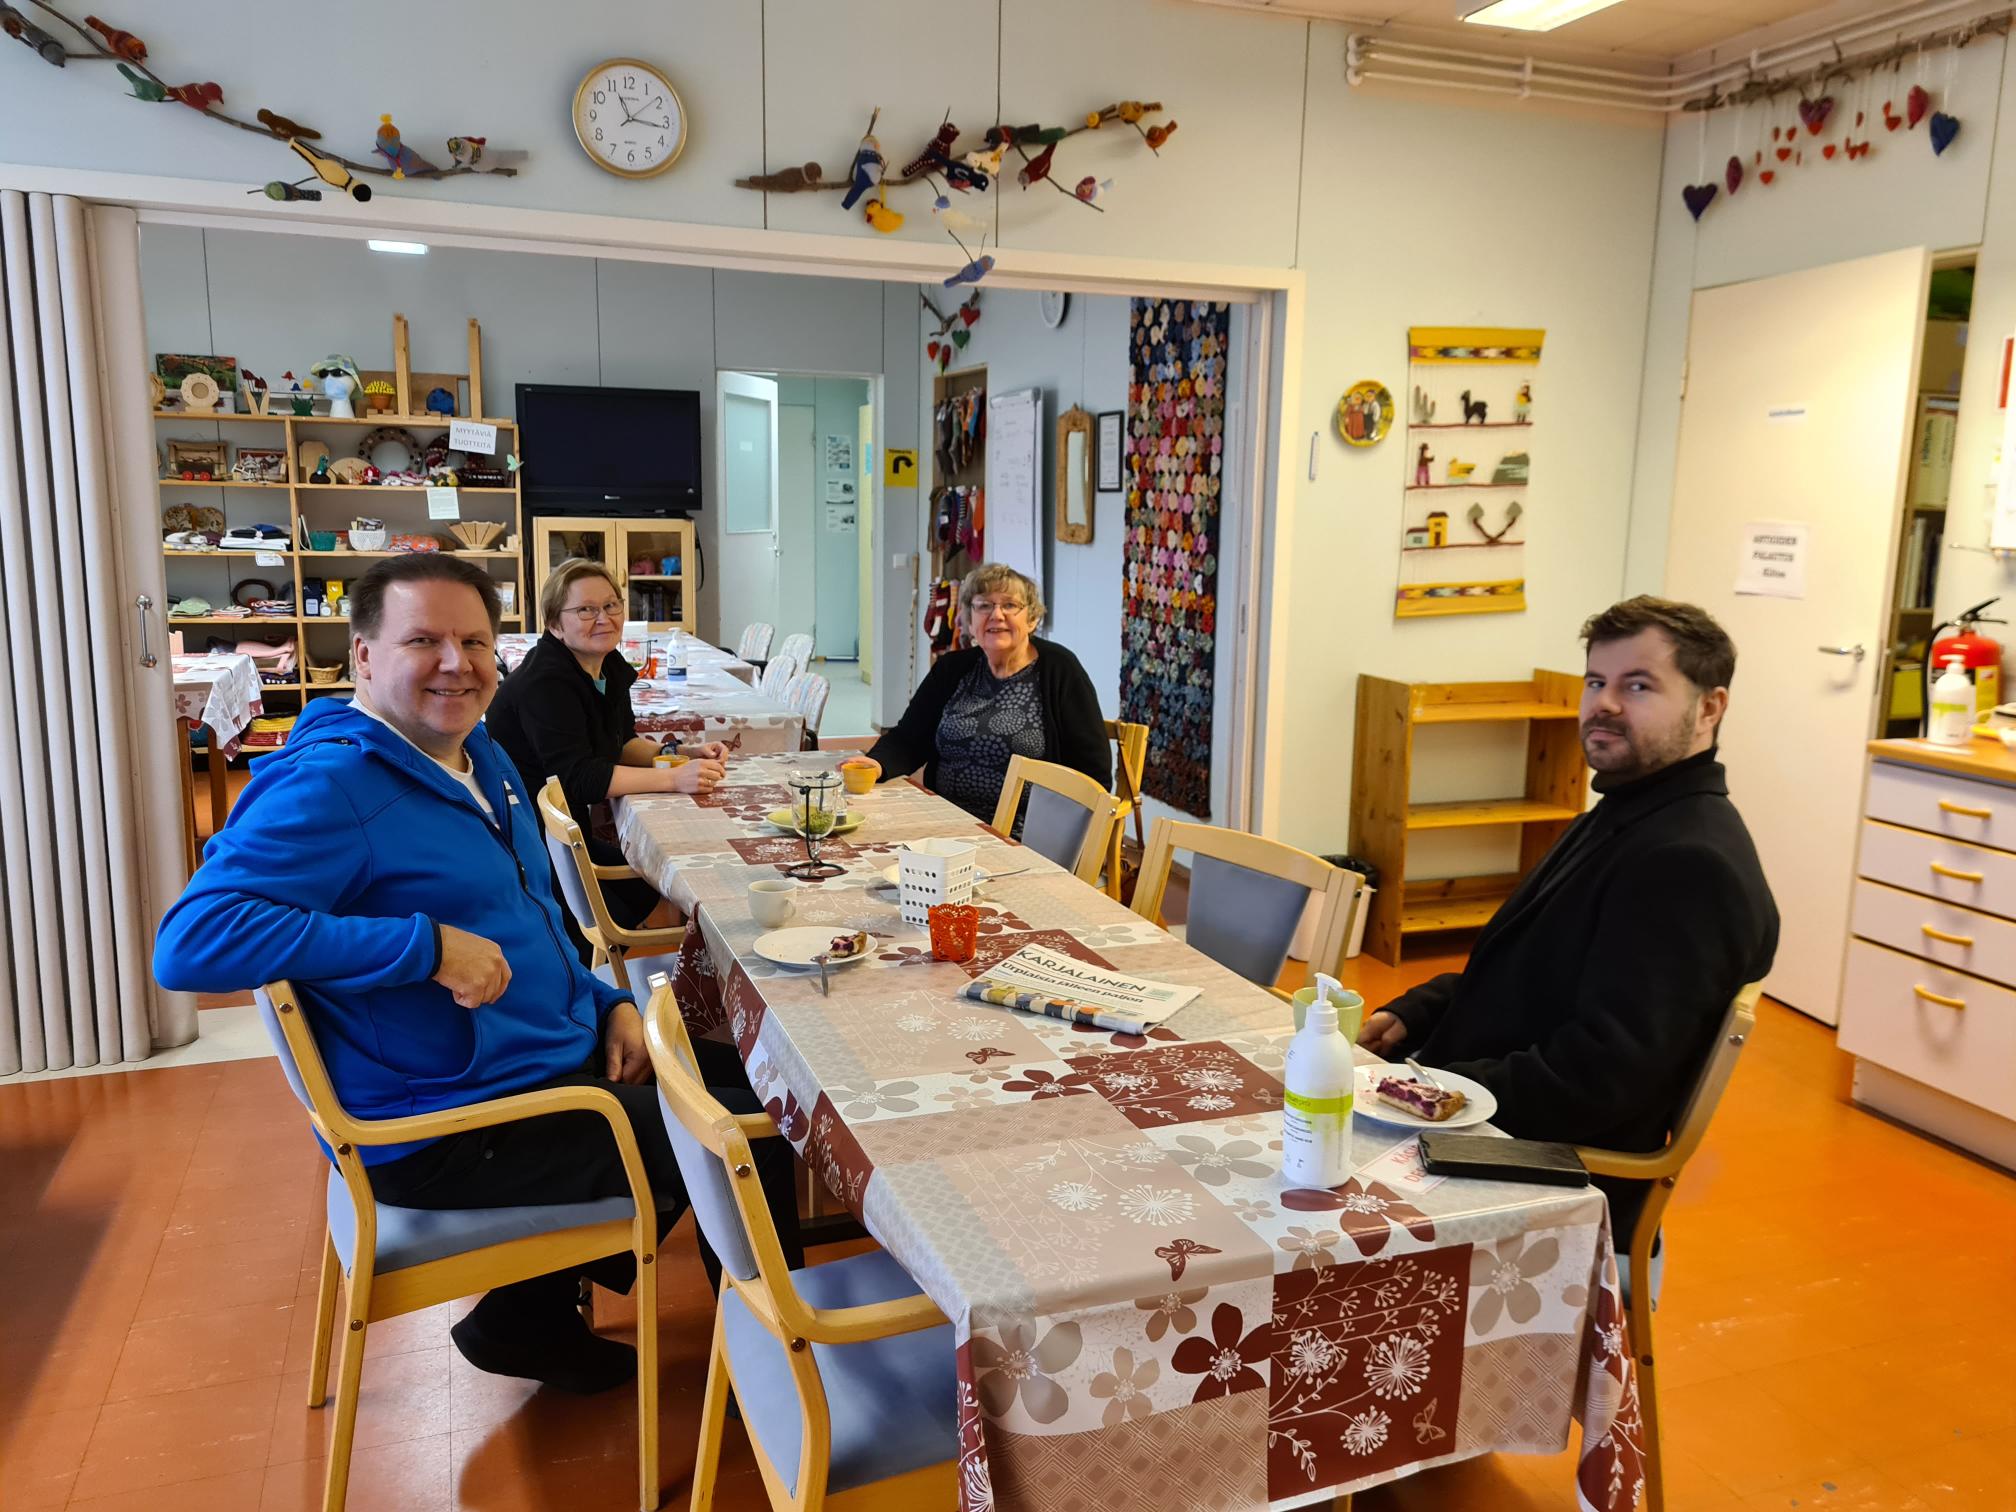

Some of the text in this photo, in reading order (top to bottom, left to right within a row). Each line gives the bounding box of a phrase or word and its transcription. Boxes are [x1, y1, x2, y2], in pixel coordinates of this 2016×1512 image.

[607, 79, 616, 92] 11
[624, 76, 635, 90] 12
[644, 82, 649, 95] 1
[593, 90, 605, 104] 10
[655, 95, 663, 109] 2
[589, 109, 597, 122] 9
[663, 115, 670, 129] 3
[595, 127, 603, 141] 8
[658, 135, 664, 147] 4
[609, 143, 617, 155] 7
[627, 149, 635, 162] 6
[644, 146, 652, 159] 5
[1016, 950, 1146, 991] KARJALAINEN
[1101, 991, 1144, 1003] paljon
